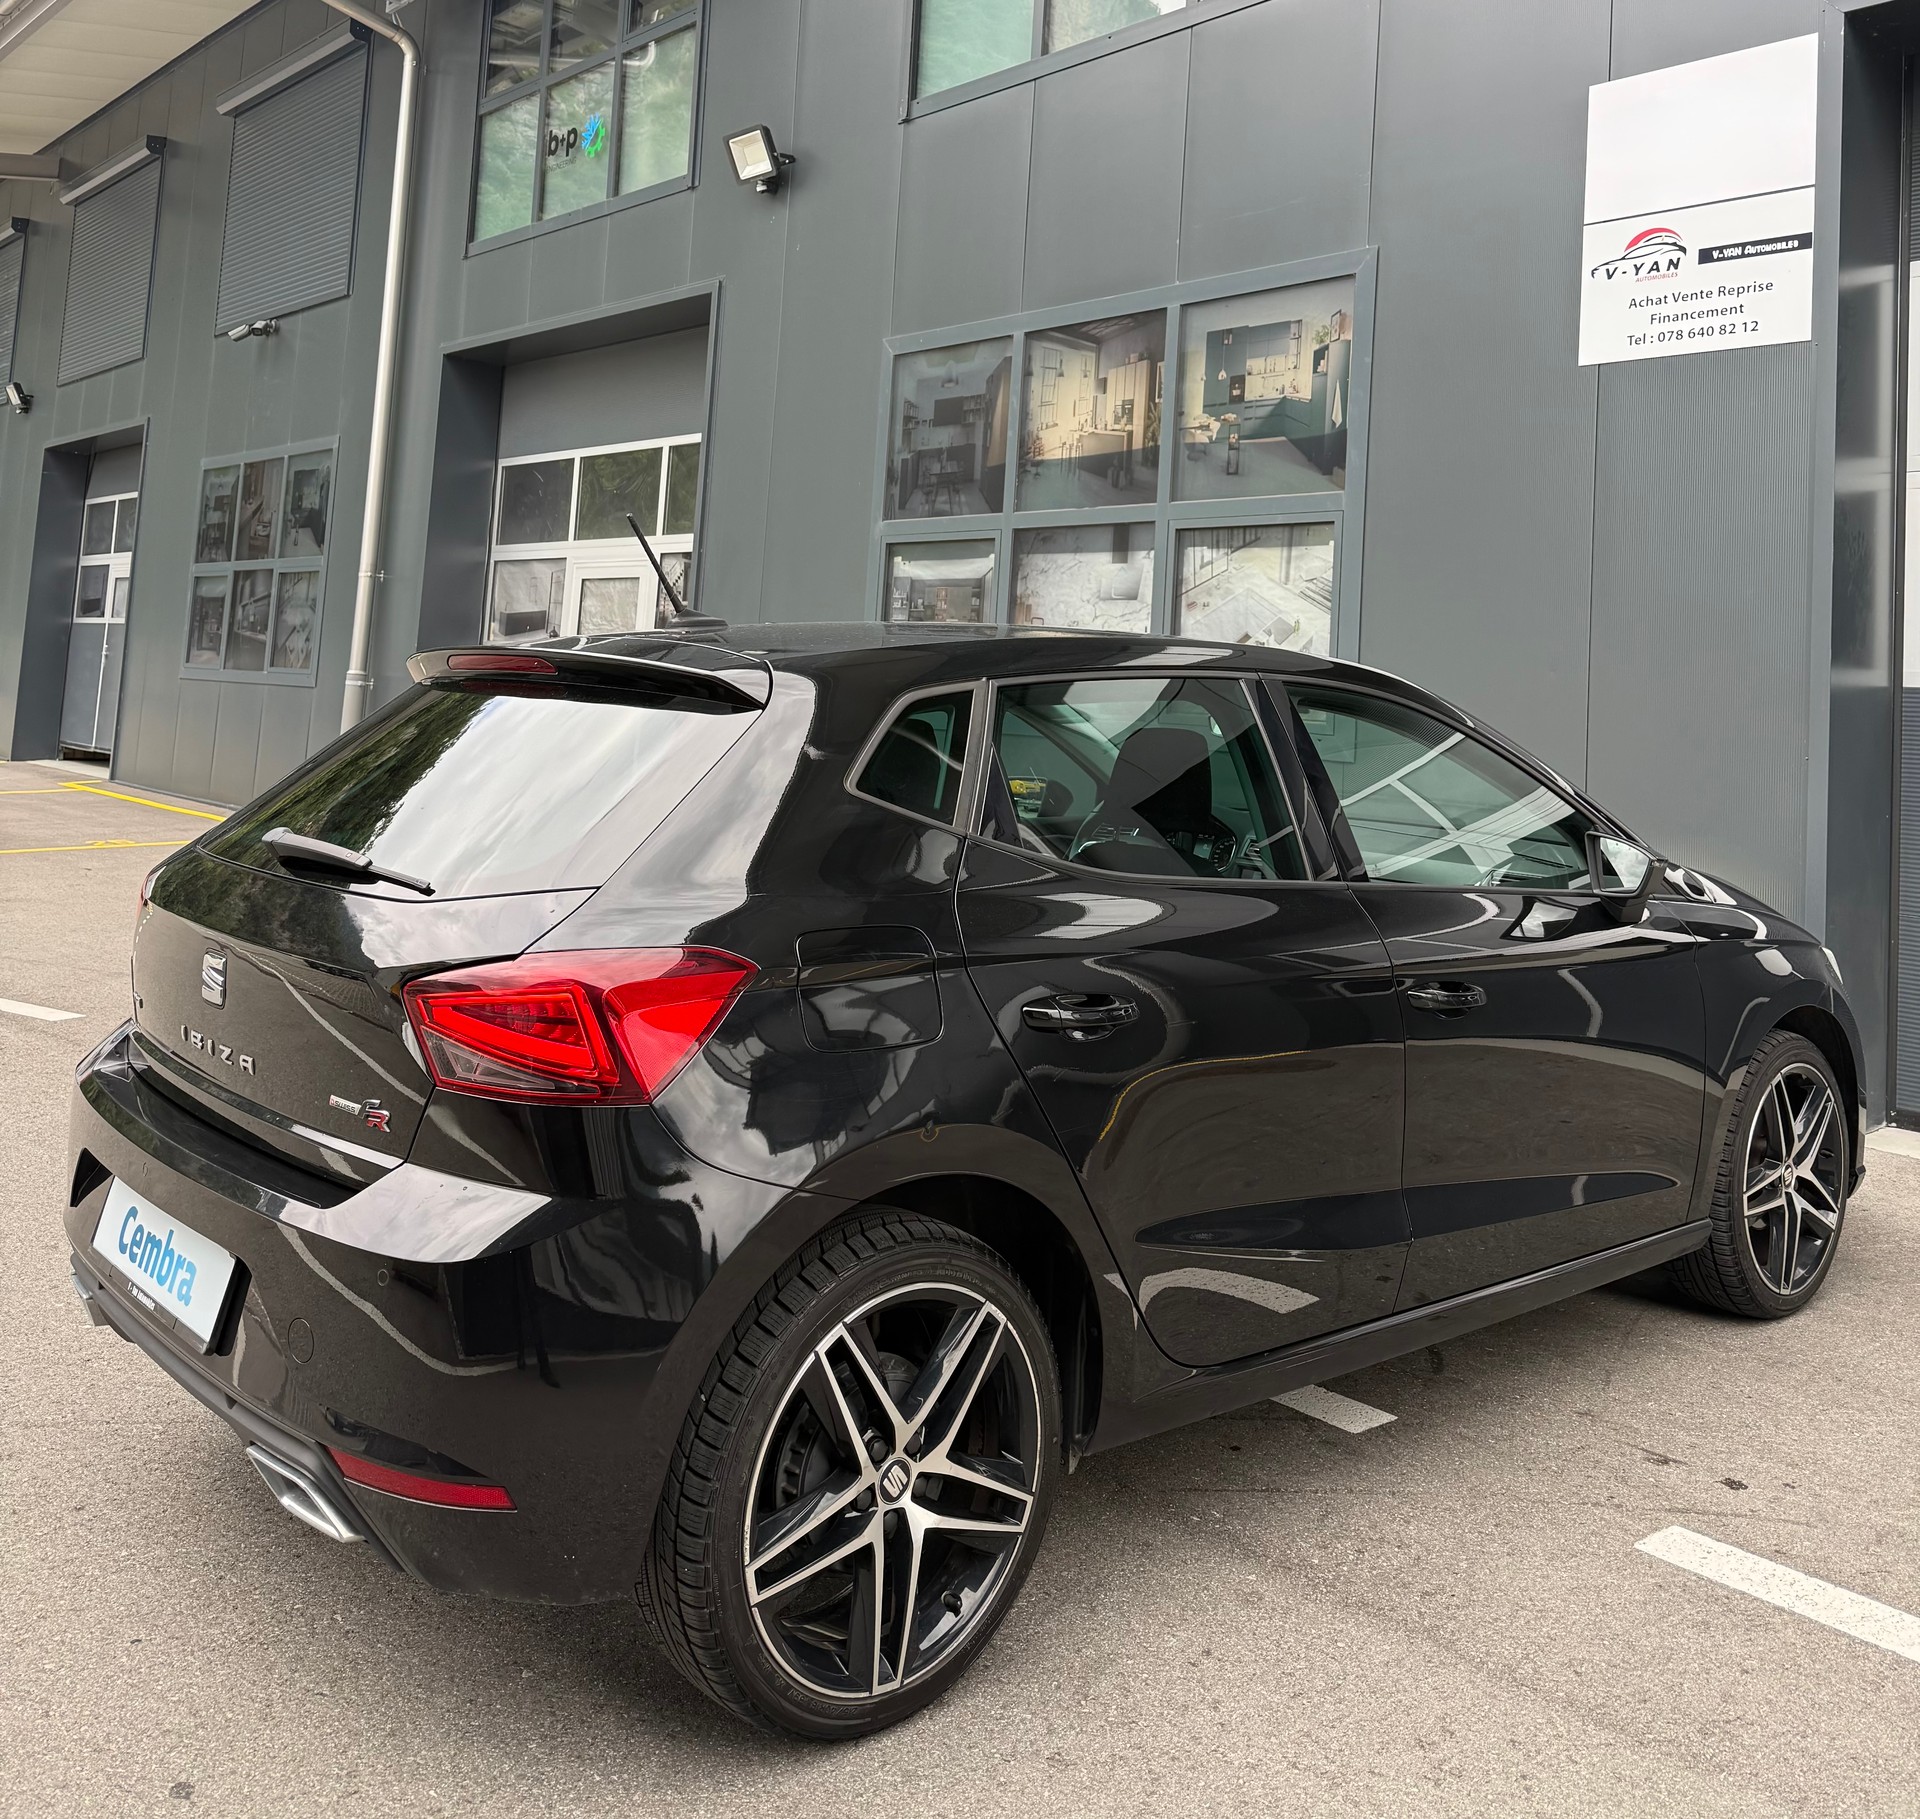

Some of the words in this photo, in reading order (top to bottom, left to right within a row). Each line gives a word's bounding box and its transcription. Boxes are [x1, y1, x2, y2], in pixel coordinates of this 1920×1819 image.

[548, 127, 578, 157] b+p
[1712, 246, 1742, 260] V-YAN
[1635, 272, 1679, 283] AUTOMOBILES
[1628, 294, 1669, 309] Achat
[1672, 289, 1714, 303] Vente
[1717, 281, 1774, 298] Reprise
[1650, 303, 1745, 325] Financement
[1627, 333, 1647, 346] Tel
[1657, 330, 1684, 343] 078
[1687, 325, 1715, 339] 640
[1718, 322, 1736, 336] 82
[1741, 320, 1759, 333] 12
[180, 1024, 256, 1076] IBIZA
[118, 1205, 198, 1307] Cembra
